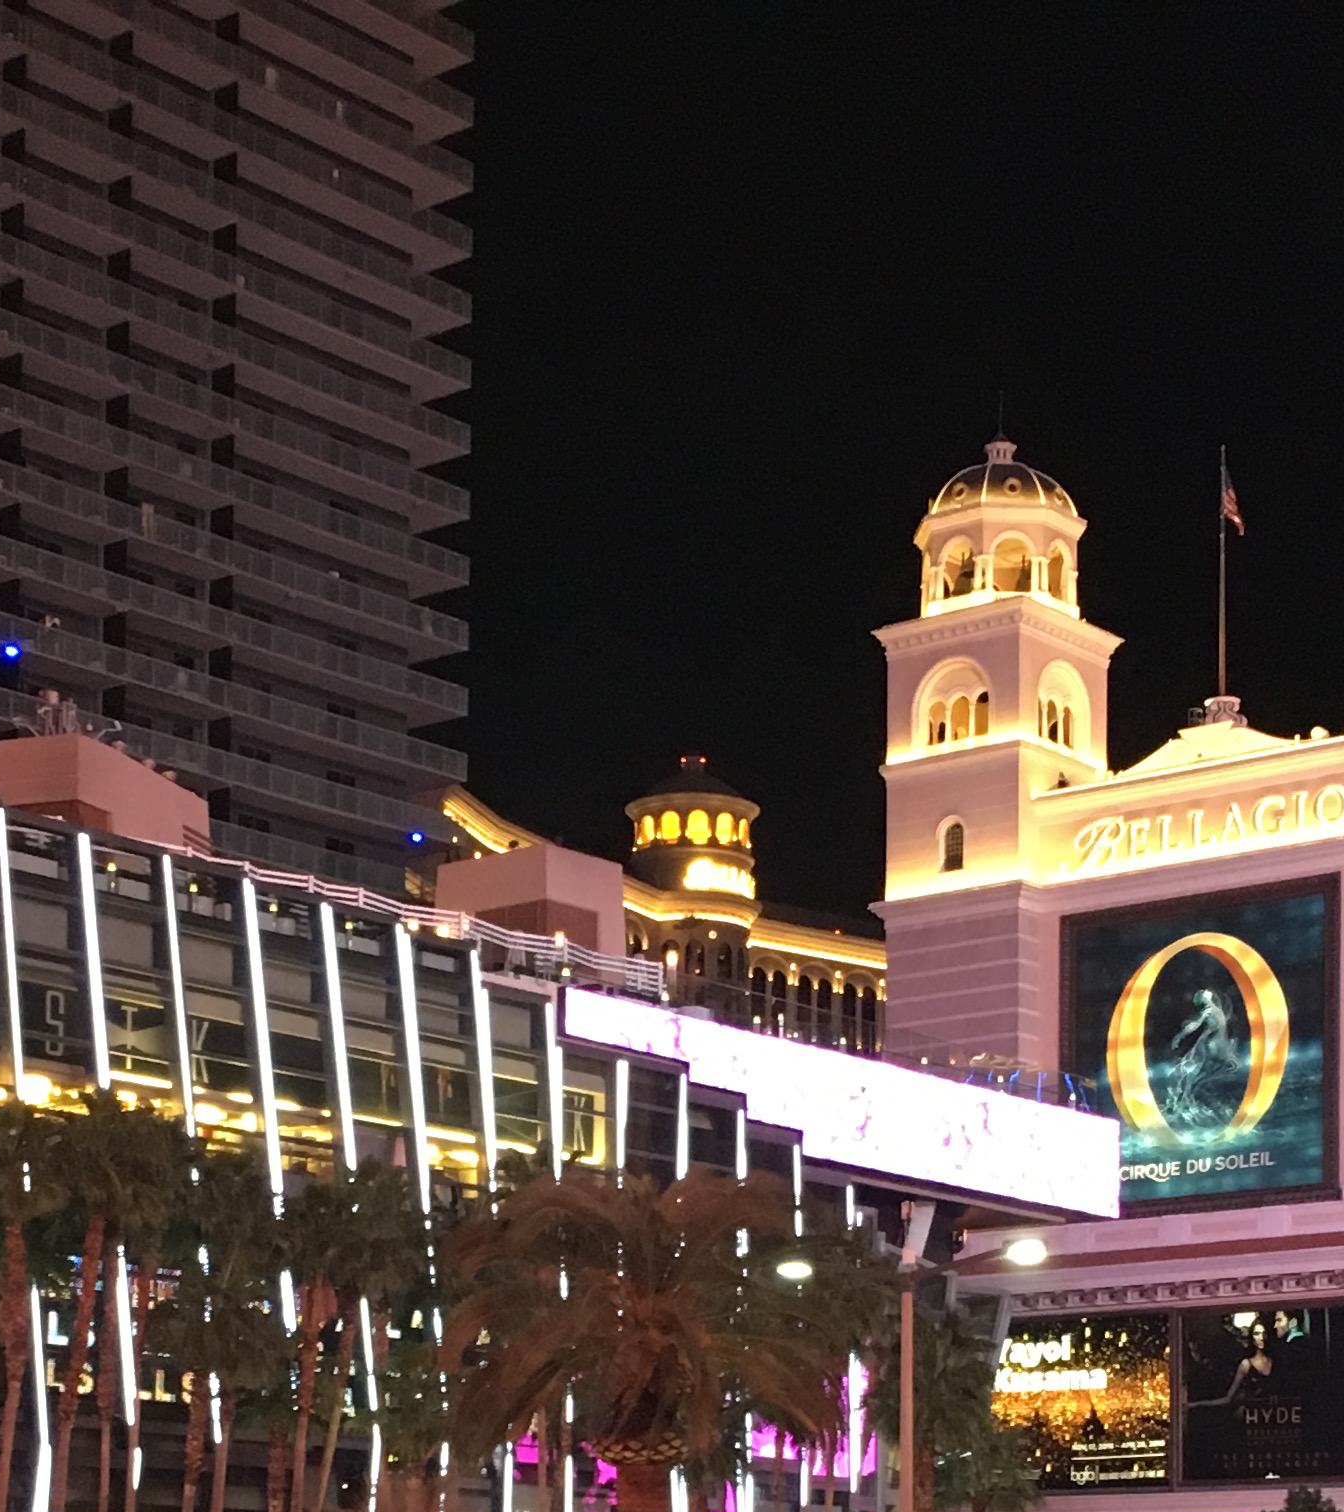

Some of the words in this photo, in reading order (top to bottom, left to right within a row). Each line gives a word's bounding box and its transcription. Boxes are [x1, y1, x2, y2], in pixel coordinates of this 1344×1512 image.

[1119, 1161, 1181, 1183] CIRQUE
[1186, 1158, 1212, 1176] DU
[1214, 1152, 1275, 1172] SOLEIL
[994, 1367, 1107, 1393] Kusama
[1245, 1407, 1302, 1425] HYDE
